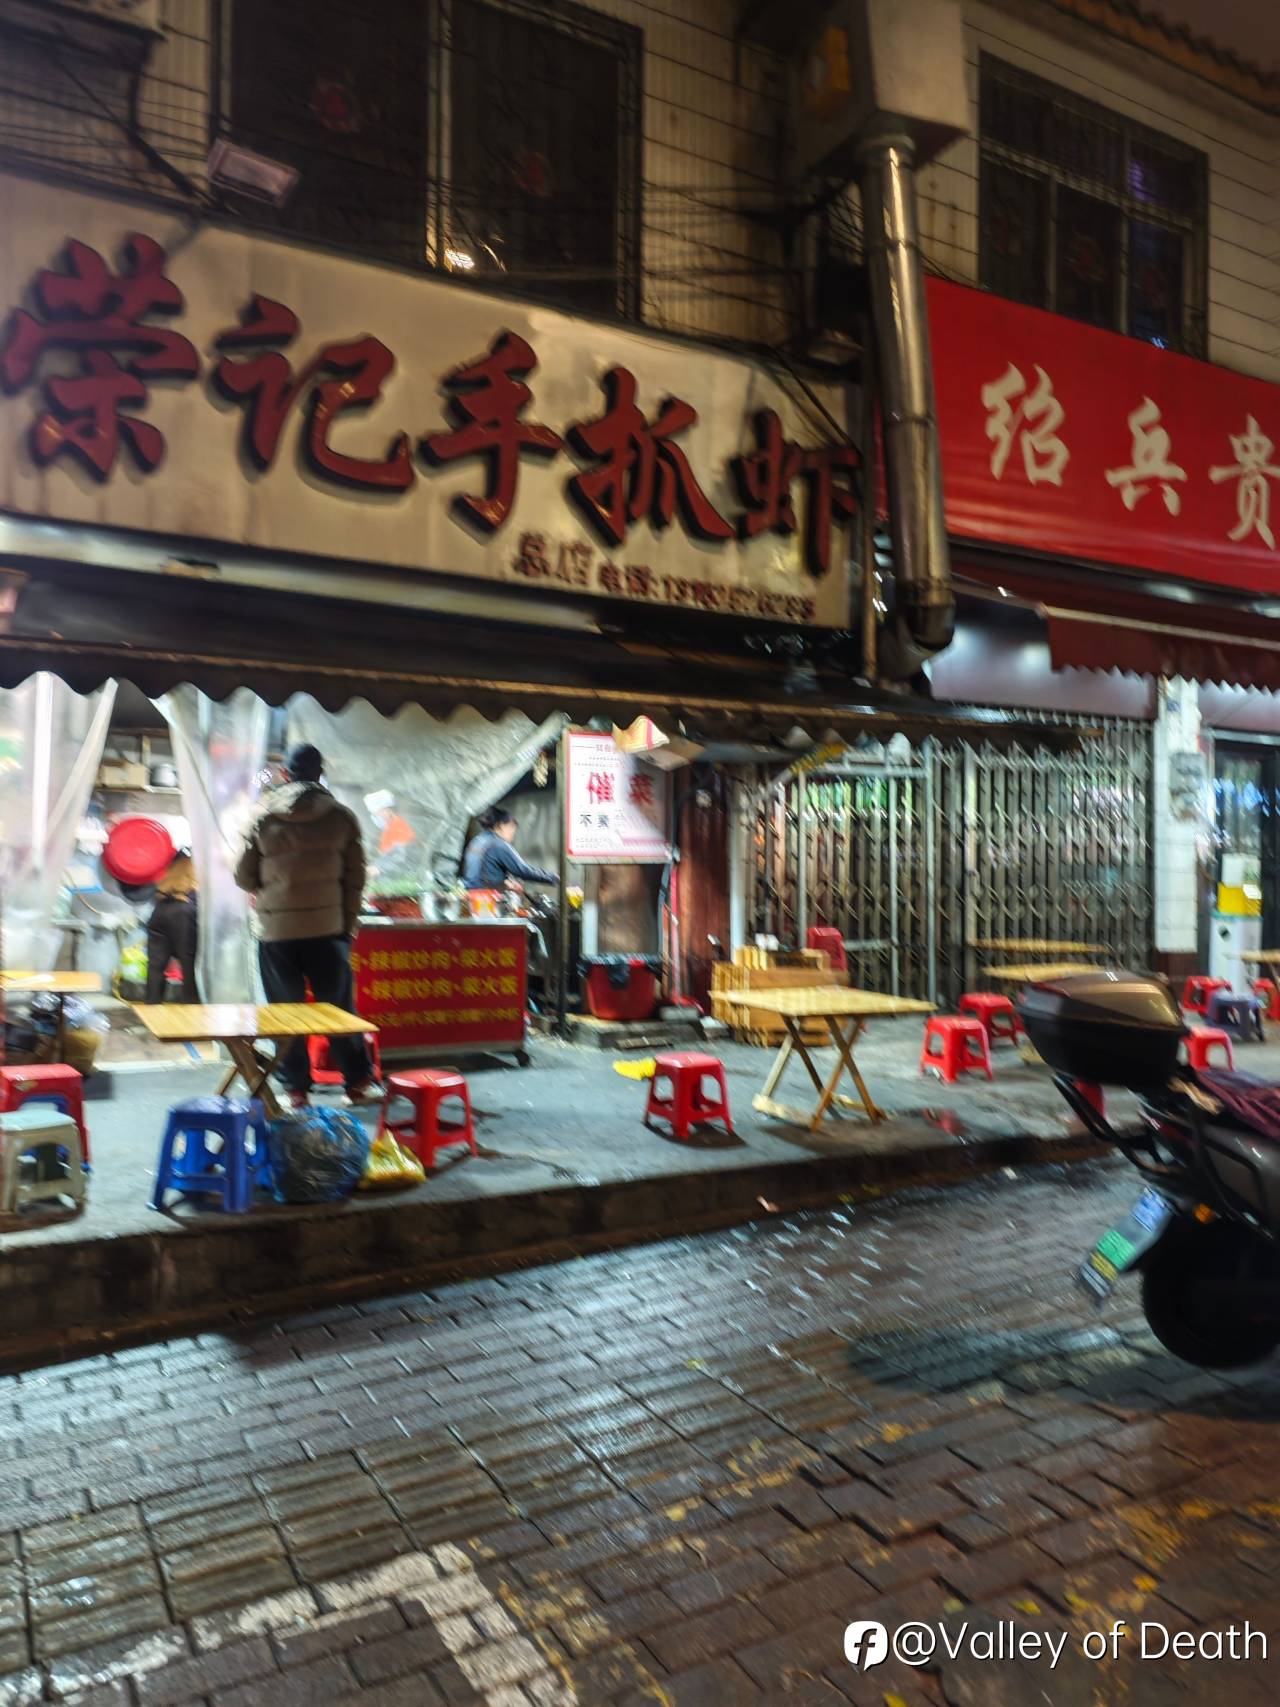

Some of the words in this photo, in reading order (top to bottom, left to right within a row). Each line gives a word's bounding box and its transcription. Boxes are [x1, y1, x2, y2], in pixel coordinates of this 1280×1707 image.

[2, 231, 862, 578] 荣记手抓虾
